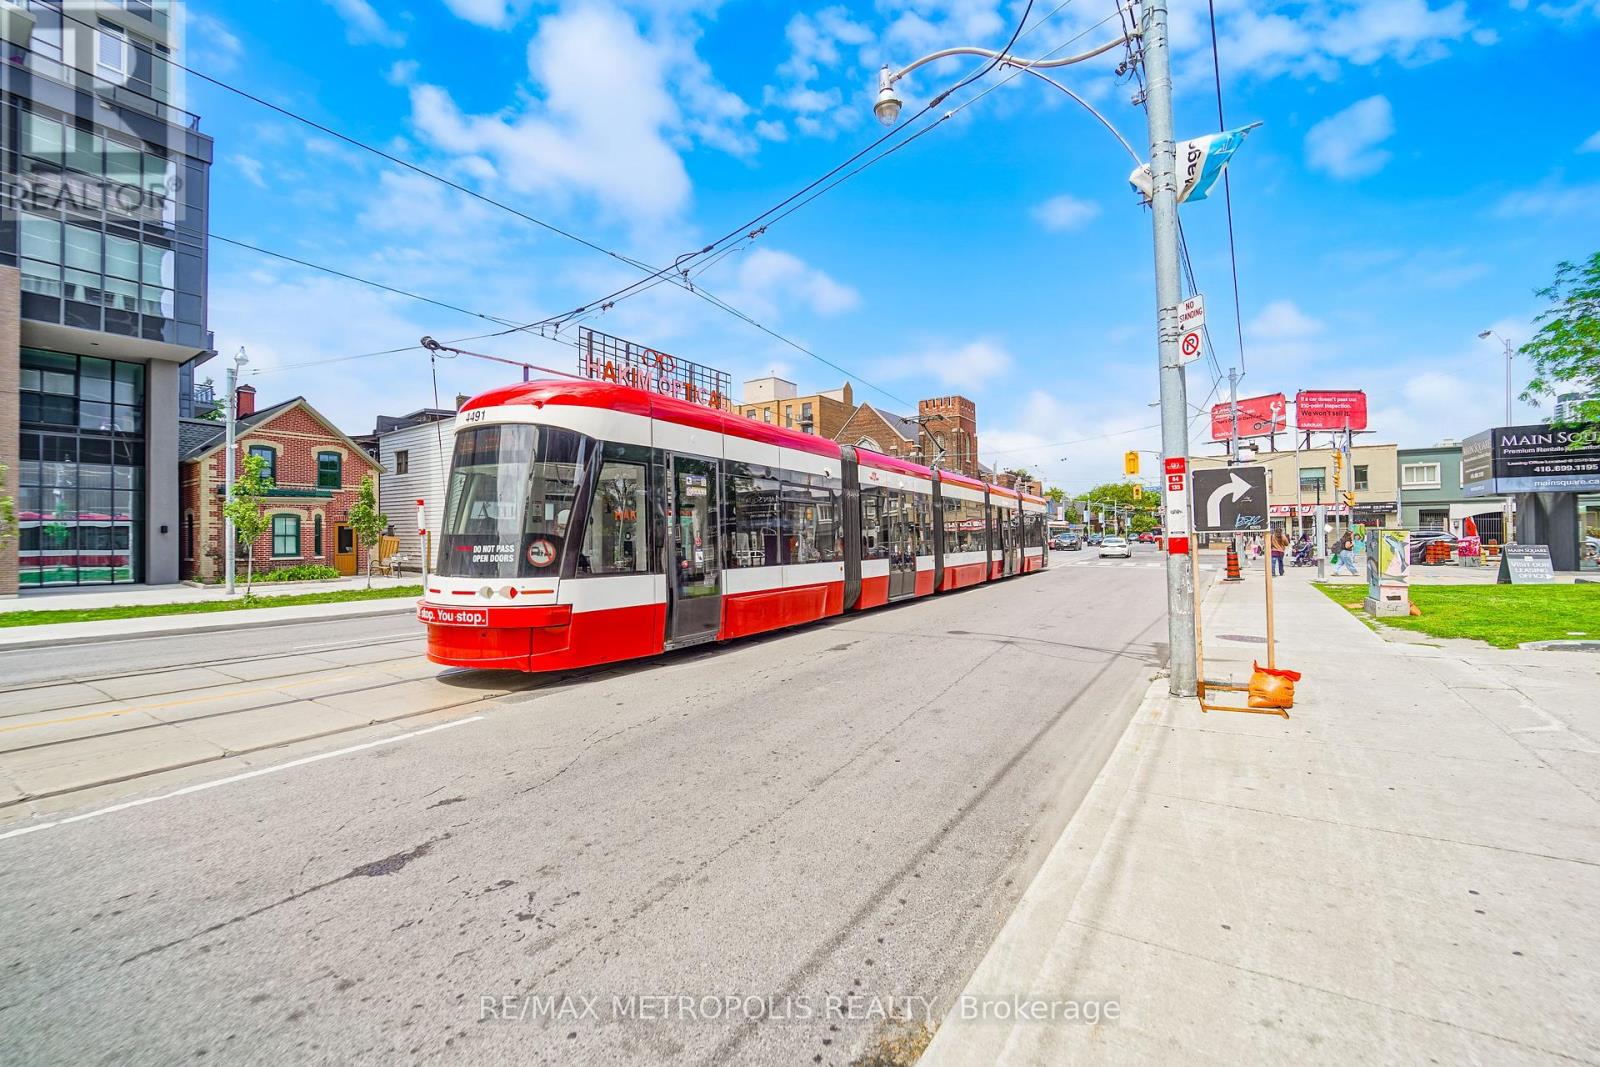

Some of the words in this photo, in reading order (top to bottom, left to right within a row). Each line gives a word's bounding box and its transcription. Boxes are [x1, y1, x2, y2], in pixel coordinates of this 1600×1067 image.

[1185, 301, 1194, 311] NO
[1179, 307, 1203, 323] STANDING
[585, 354, 651, 390] HAKIM
[1502, 434, 1552, 446] MAIN
[1534, 464, 1598, 472] 416.699.1195
[1534, 479, 1600, 487] mainsquare.ca
[473, 545, 482, 553] DO
[482, 545, 495, 553] NOT
[496, 545, 514, 553] PASS
[490, 554, 514, 562] DOORS
[437, 609, 454, 621] You
[457, 611, 485, 625] stop.
